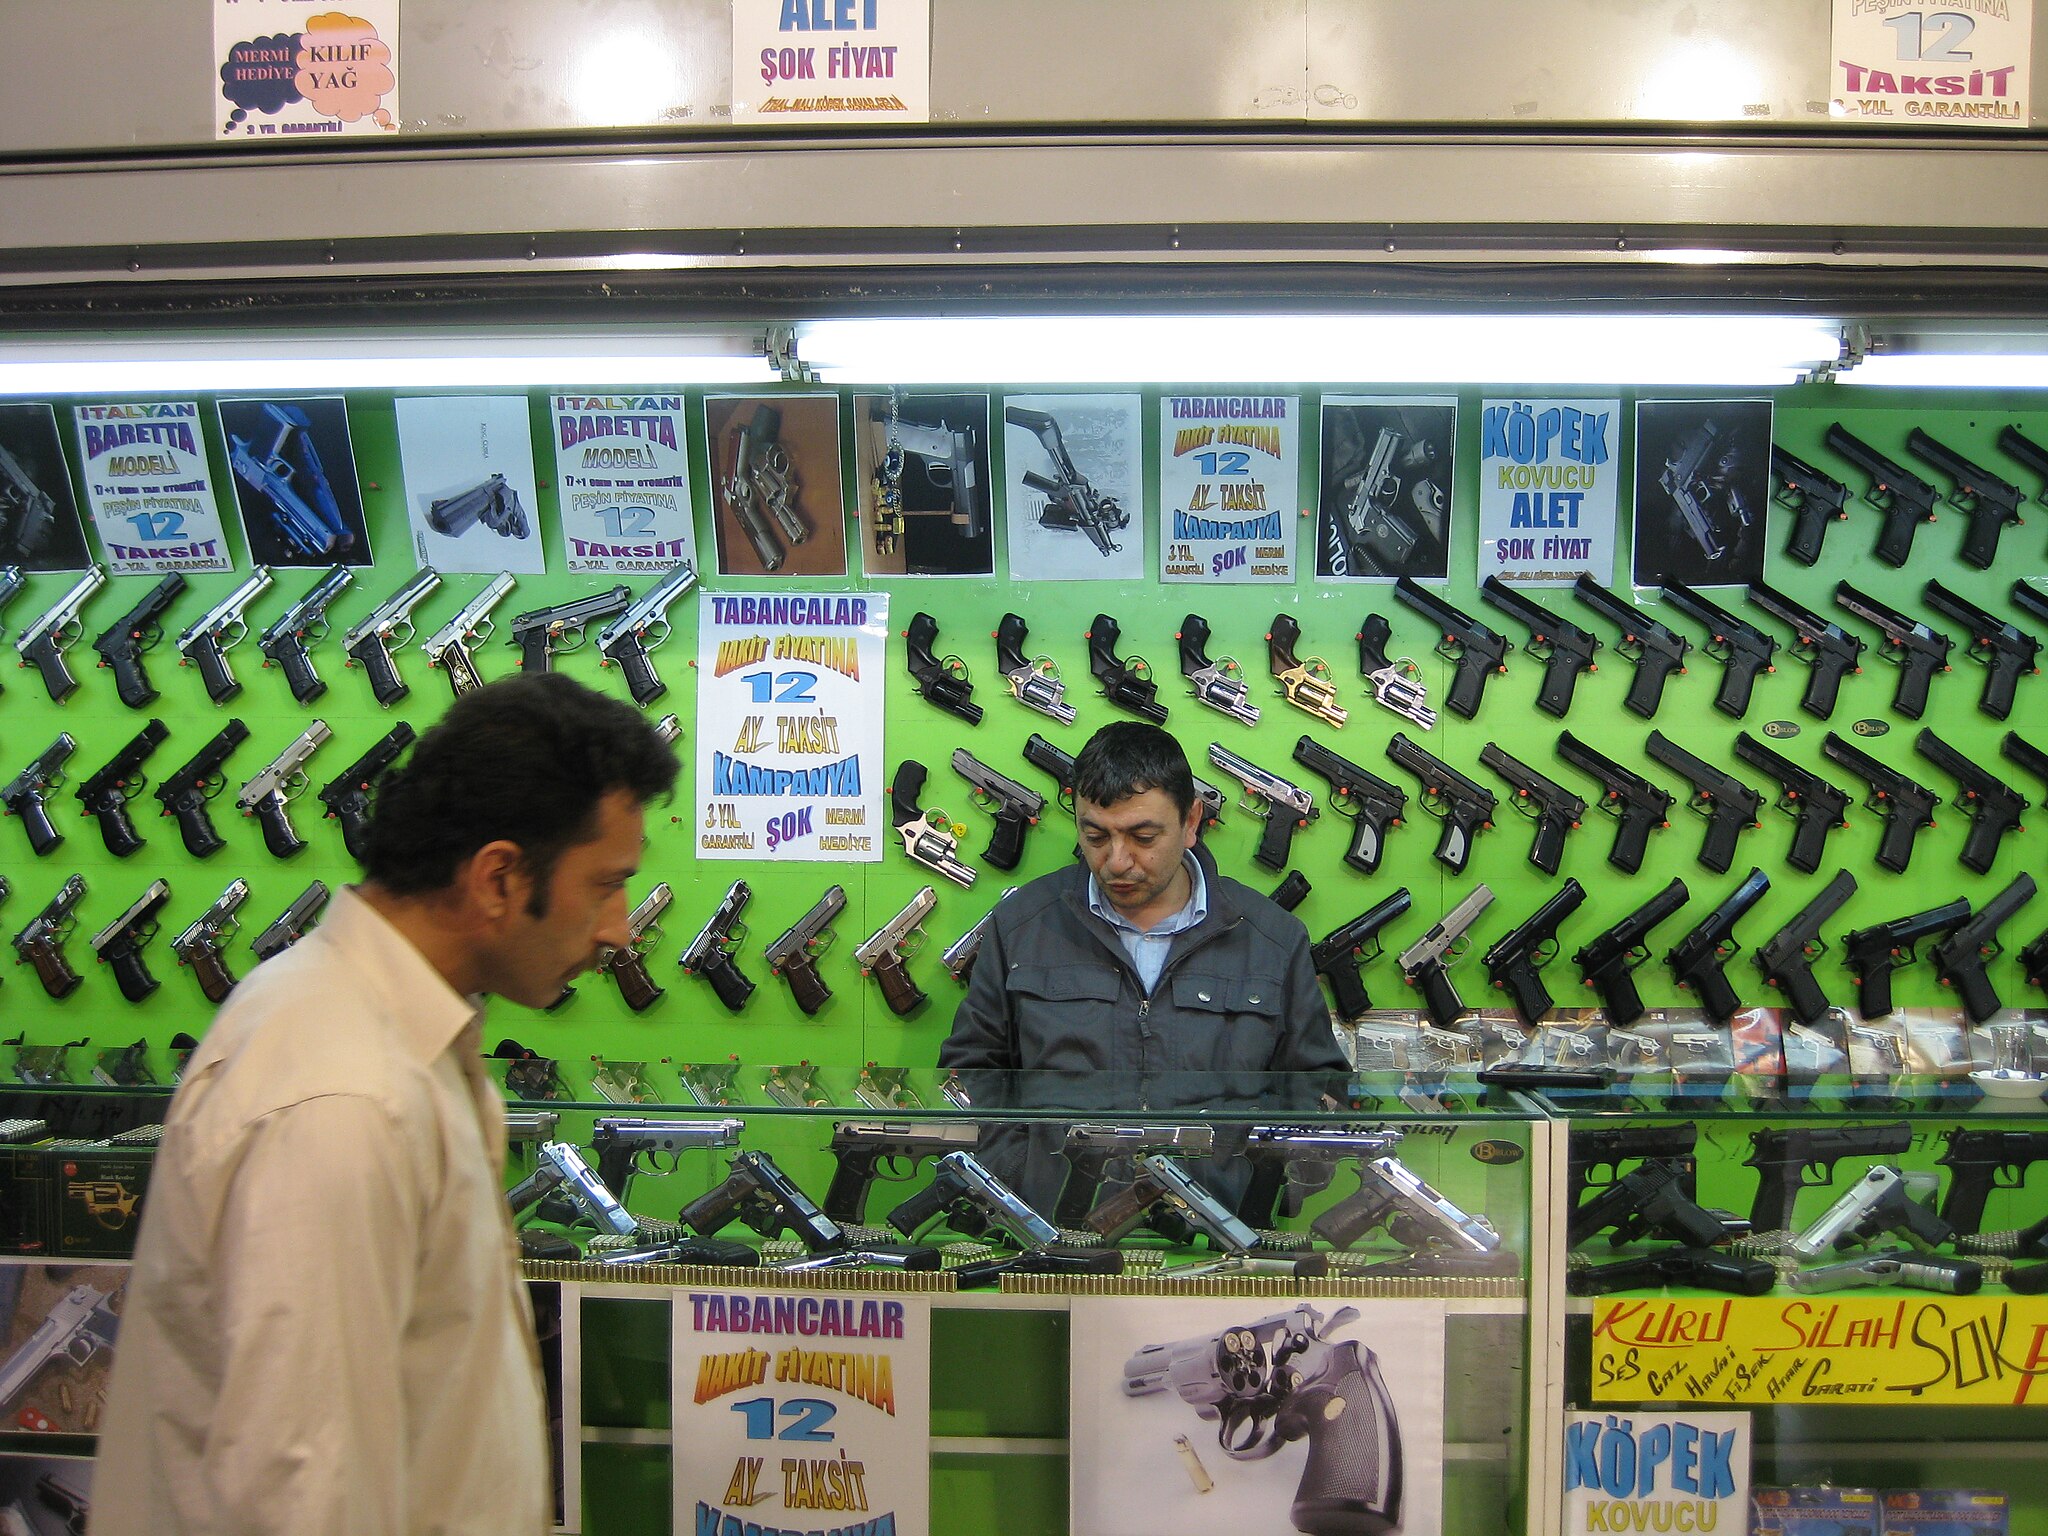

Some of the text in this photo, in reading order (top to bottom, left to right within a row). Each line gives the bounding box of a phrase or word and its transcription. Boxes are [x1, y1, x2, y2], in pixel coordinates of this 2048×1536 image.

[1882, 11, 1975, 62] 12
[236, 47, 291, 63] MERMİ
[310, 44, 372, 63] KILIF
[761, 41, 898, 87] ŞOK FİYAT
[235, 65, 294, 81] HEDİYE
[309, 66, 358, 90] YAĞ
[1839, 60, 2015, 97] TAKSİT
[1857, 99, 1894, 115] YIL
[1904, 100, 2020, 119] GARANTİLİ
[81, 404, 196, 420] ITALYAN
[557, 397, 681, 411] ITALYAN
[1170, 398, 1286, 419] TABANCALAR
[84, 422, 198, 460] BARETTA
[559, 416, 679, 451] BARETTA
[1217, 424, 1281, 460] FİYATINA
[1482, 401, 1610, 465] KÖPEK
[108, 450, 181, 477] MODELİ
[581, 444, 658, 469] MODELİ
[1192, 451, 1250, 475] 12
[1498, 465, 1596, 489] KOVUCU
[571, 490, 678, 512] PEŞİN FİYATINA
[1188, 478, 1267, 511] AY TAKSİT
[1510, 492, 1585, 528] ALET
[126, 511, 189, 541] 12
[593, 506, 657, 537] 12
[1173, 509, 1282, 540] KAMPANYA
[107, 538, 217, 560] TAKSİT
[569, 537, 686, 557] TAKSİT
[1212, 545, 1247, 577] ŞOK
[1496, 535, 1592, 564] ŞOK FİYAT
[711, 597, 868, 625] TABANCALAR
[773, 633, 860, 683] FİYATINA
[740, 671, 818, 704] 12
[733, 707, 840, 754] AY TAKSİT
[712, 750, 862, 797] KAMPANYA
[705, 803, 742, 829] 3 YIL
[766, 805, 814, 852] ŞOK
[825, 805, 866, 825] MERMİ
[701, 831, 755, 850] GARANTİLİ
[819, 833, 872, 851] HEDİYE
[689, 1293, 904, 1339] TABANCALAR
[1593, 1300, 1732, 1348] KURU
[775, 1346, 895, 1418] FİYATINA
[730, 1397, 838, 1442] 12
[1565, 1414, 1737, 1500] KÖPEK
[723, 1448, 869, 1512] AY TAKSİT
[1586, 1501, 1718, 1533] KOVUCU
